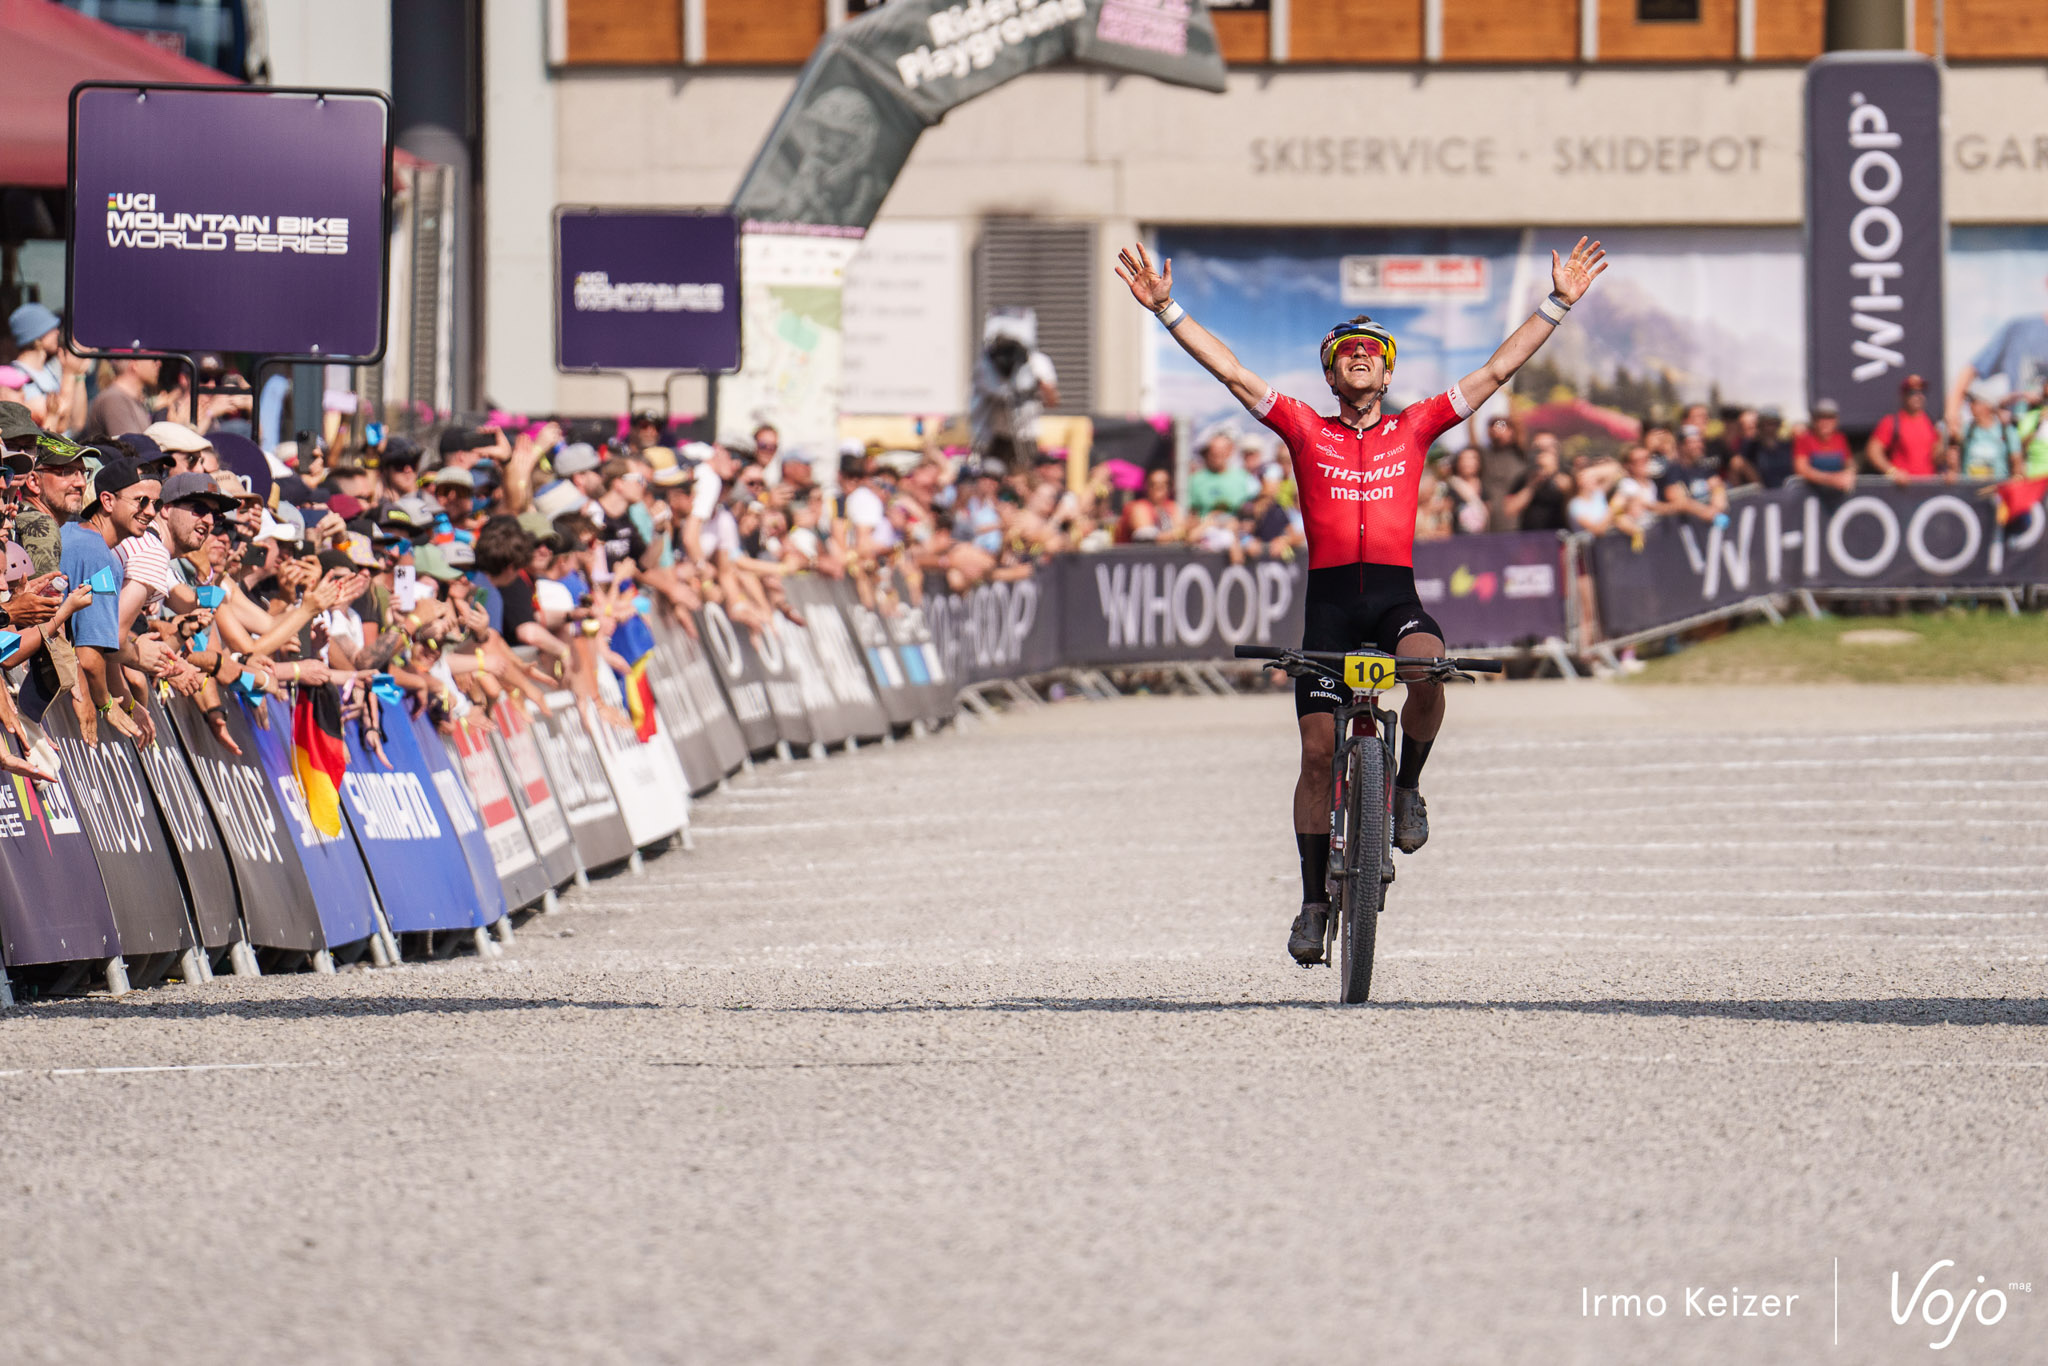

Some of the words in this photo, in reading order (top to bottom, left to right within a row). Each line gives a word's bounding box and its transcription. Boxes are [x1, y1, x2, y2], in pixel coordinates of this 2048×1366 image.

[1250, 137, 1496, 176] SKISERVICE
[1553, 136, 1765, 175] SKIDEPOT
[116, 193, 156, 211] UCI
[107, 211, 270, 233] MOUNTAIN
[277, 216, 349, 235] BIKE
[107, 230, 227, 250] WORLD
[234, 233, 349, 255] SERIES
[1848, 103, 1904, 382] WHOOP
[1330, 485, 1394, 502] maxon
[1095, 562, 1294, 649] WHOOP
[1355, 661, 1385, 684] 10
[1310, 690, 1343, 704] maxon
[55, 736, 152, 853] WHOOP
[140, 746, 213, 852] HOOP
